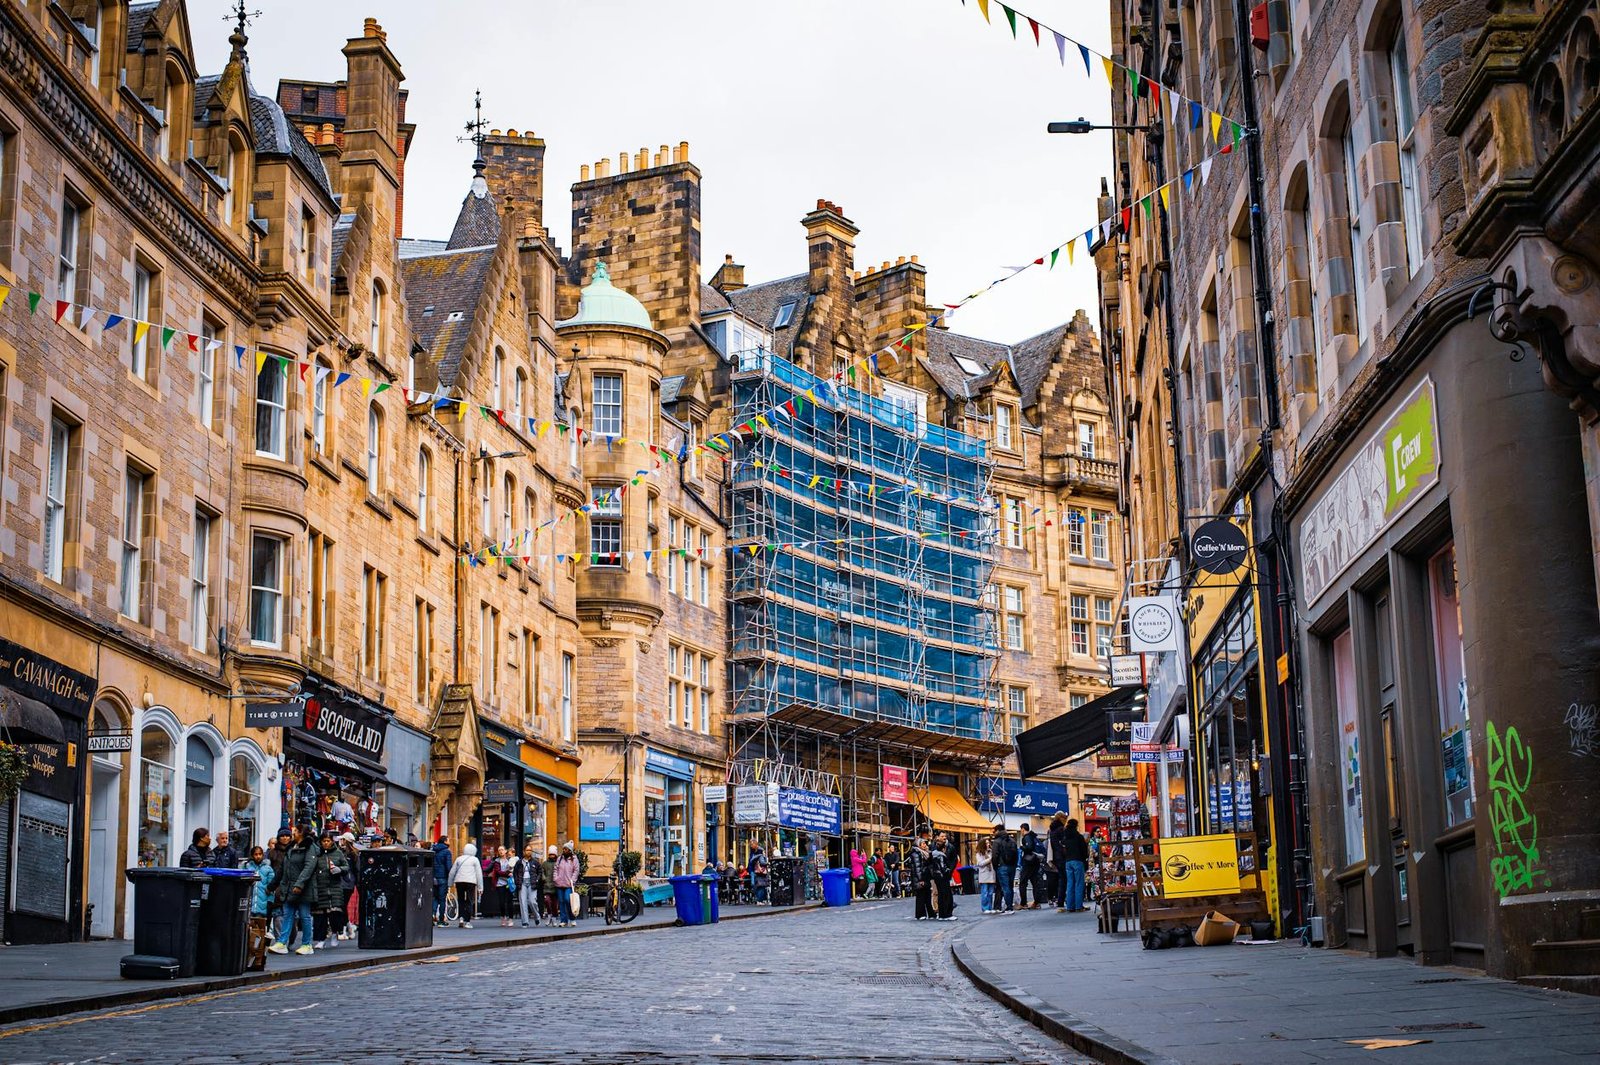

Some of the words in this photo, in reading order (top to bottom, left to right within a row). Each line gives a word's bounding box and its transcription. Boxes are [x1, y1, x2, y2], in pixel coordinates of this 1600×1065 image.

[1401, 432, 1421, 470] CREW
[1197, 544, 1219, 552] Coffee
[14, 657, 75, 698] CAVANAGH
[317, 707, 382, 753] SCOTLAND
[89, 737, 131, 750] ANTIQUES
[32, 753, 55, 778] Shoppe
[1042, 800, 1059, 809] Beauty
[1216, 860, 1235, 868] More
